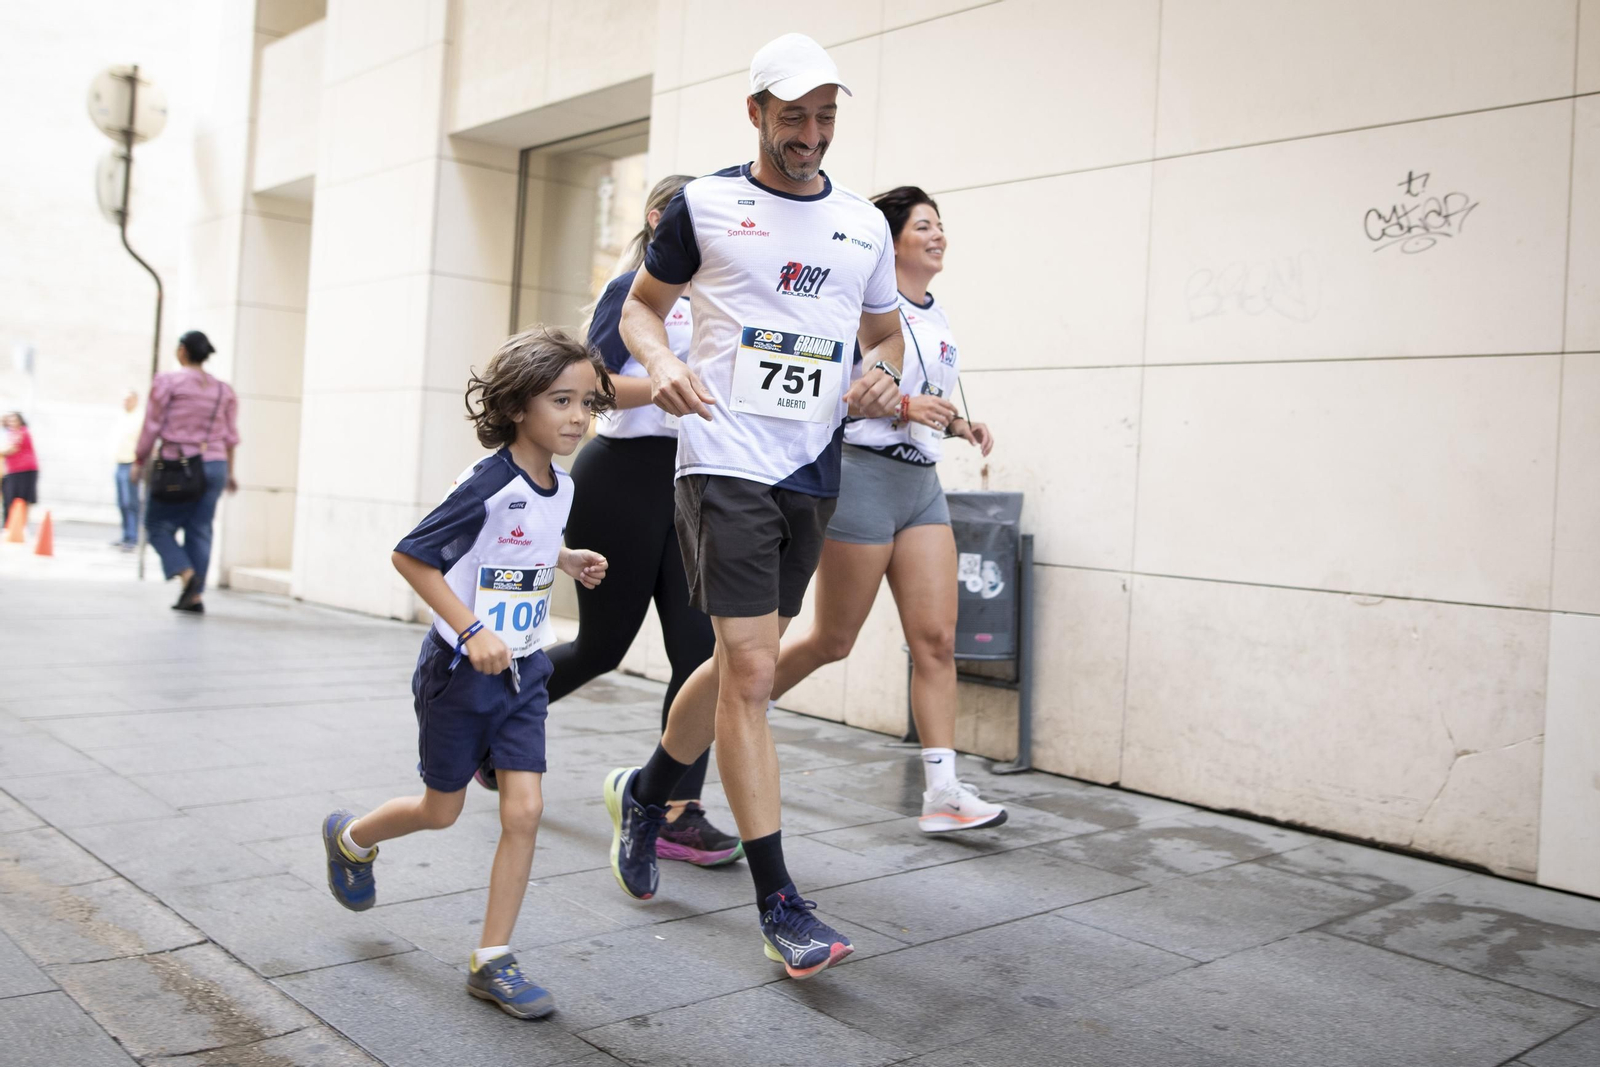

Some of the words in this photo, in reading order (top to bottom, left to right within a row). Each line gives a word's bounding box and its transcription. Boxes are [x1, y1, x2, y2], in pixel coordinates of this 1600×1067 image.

[727, 229, 770, 238] Santander
[781, 290, 819, 299] SOLIDARIA
[754, 329, 783, 344] 200
[793, 335, 836, 357] GRANADA
[759, 360, 822, 398] 751
[777, 397, 806, 410] ALBERTO
[497, 536, 532, 546] Santander
[494, 569, 524, 583] 200
